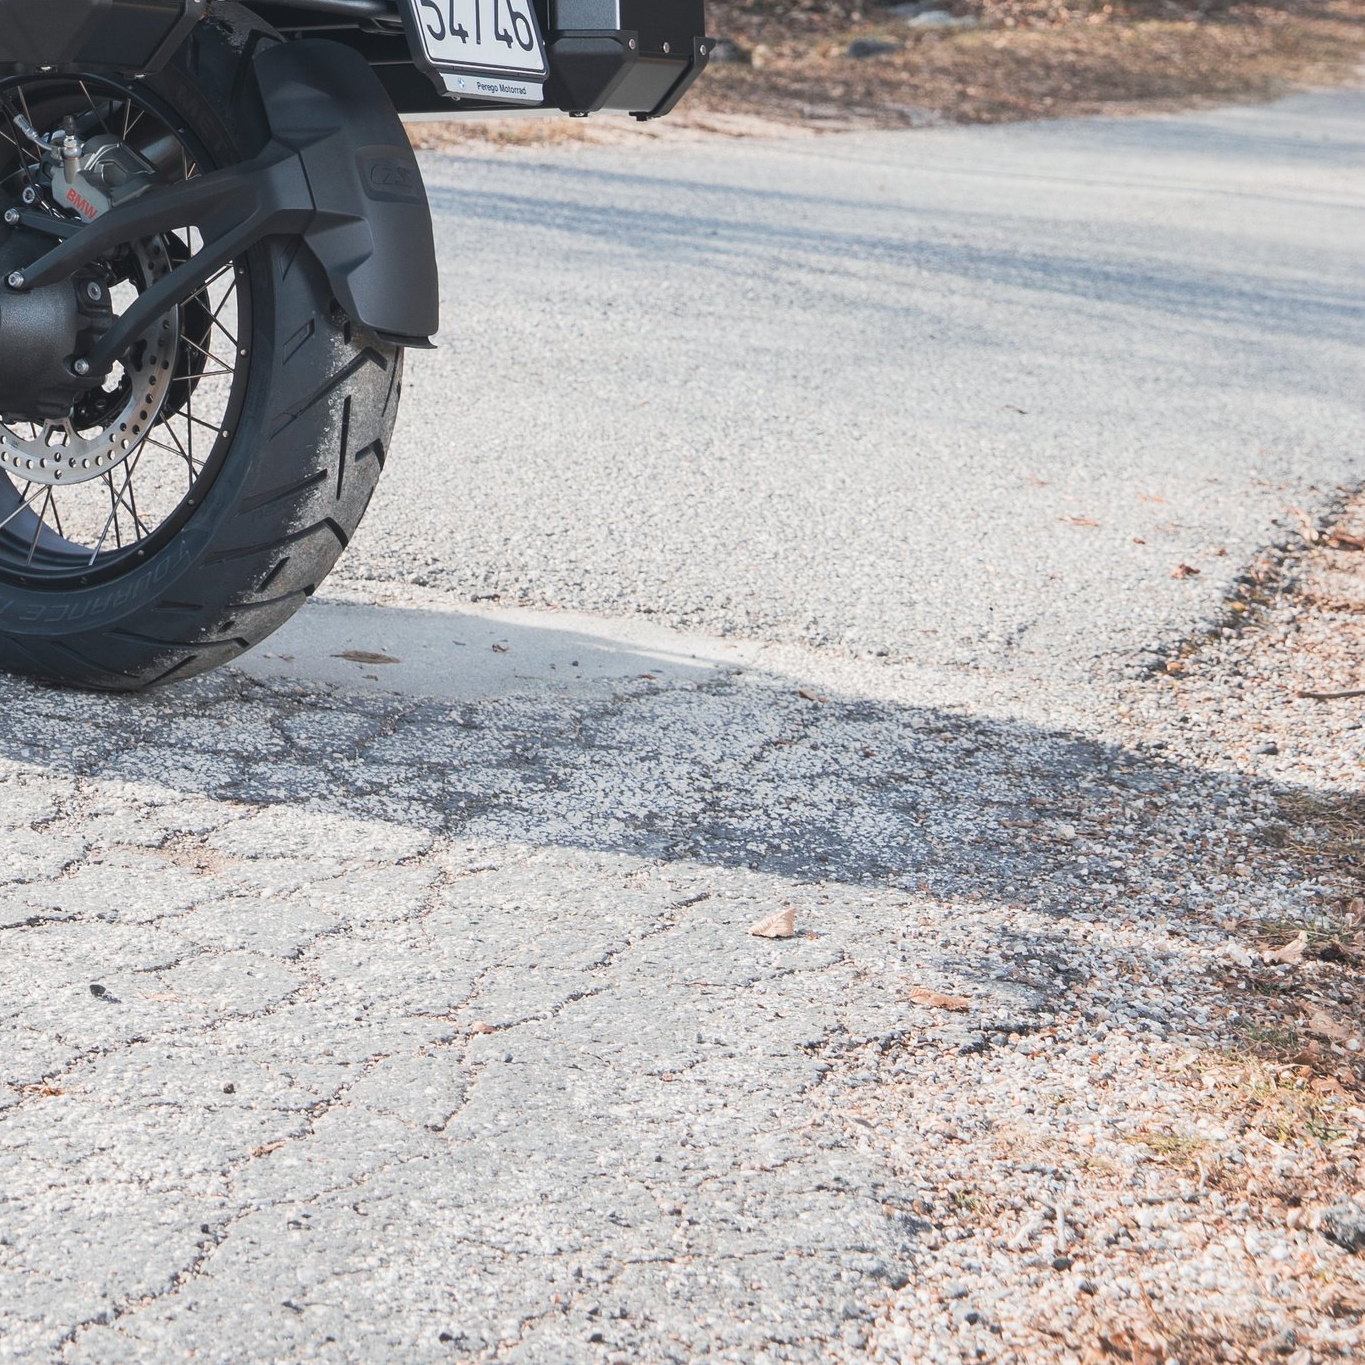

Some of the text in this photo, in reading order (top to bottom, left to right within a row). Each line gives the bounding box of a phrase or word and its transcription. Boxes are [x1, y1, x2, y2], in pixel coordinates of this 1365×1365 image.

[476, 81, 527, 95] Perego Motorrad
[66, 187, 98, 219] BMW
